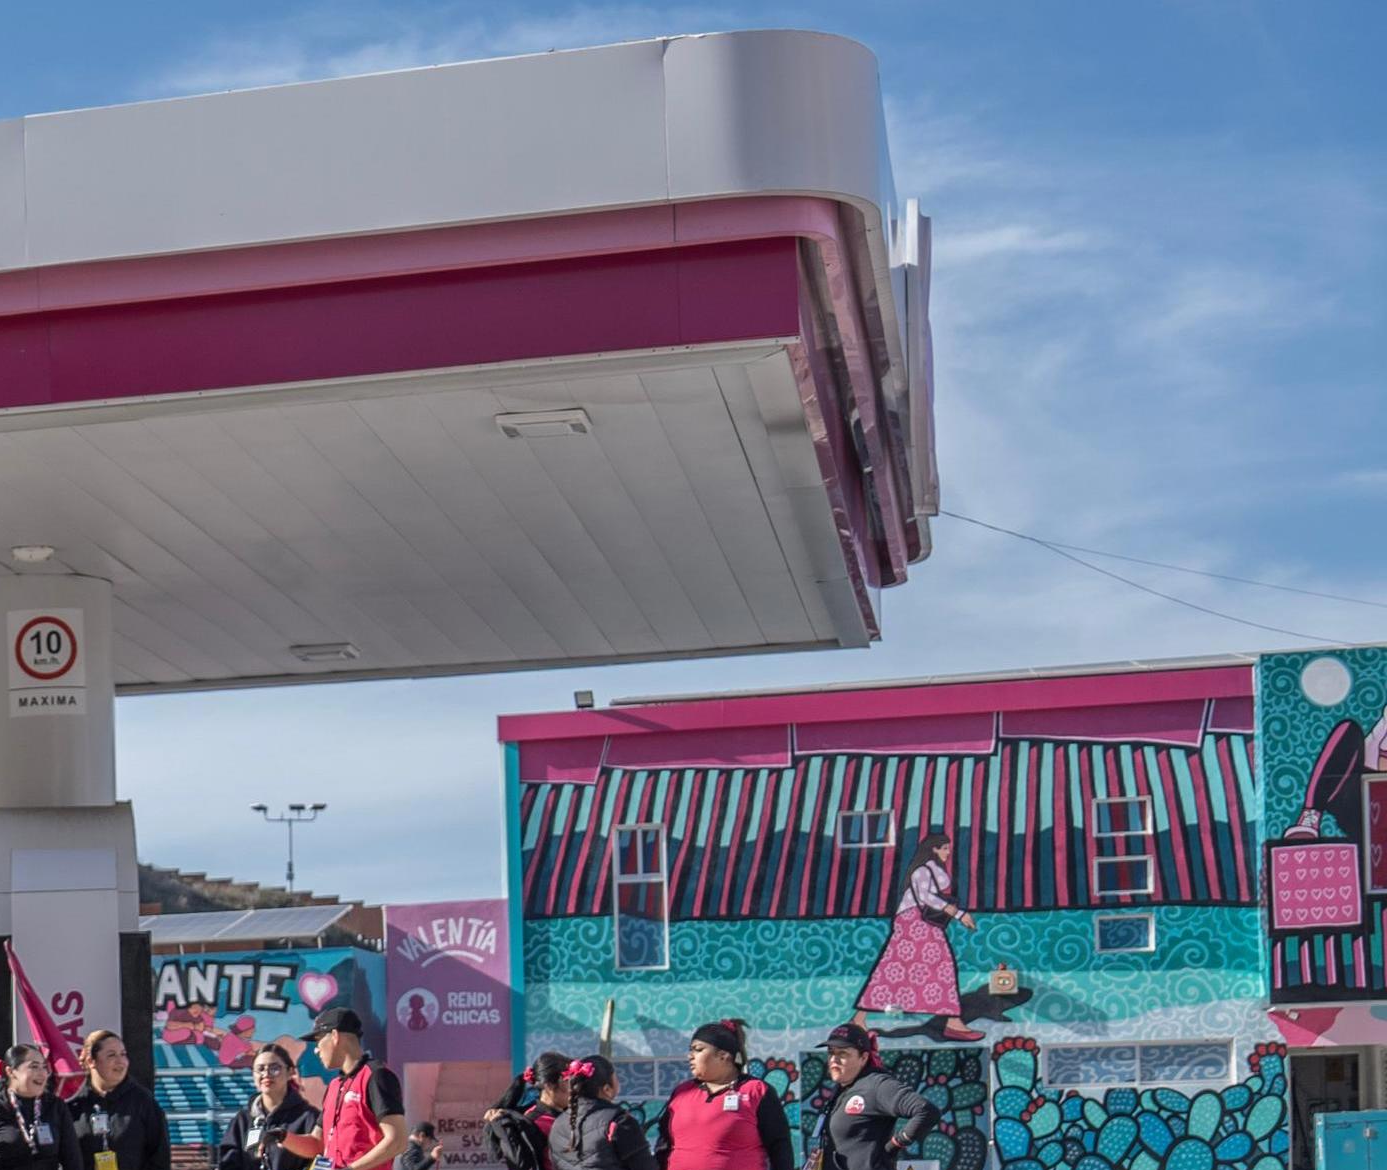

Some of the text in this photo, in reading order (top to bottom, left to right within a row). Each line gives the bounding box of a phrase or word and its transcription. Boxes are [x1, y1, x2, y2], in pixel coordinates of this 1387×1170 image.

[30, 630, 62, 655] 10
[19, 695, 77, 707] MAXIMA
[155, 963, 293, 1010] ANTE
[448, 991, 492, 1008] RENDI
[442, 1009, 501, 1025] CHICAS
